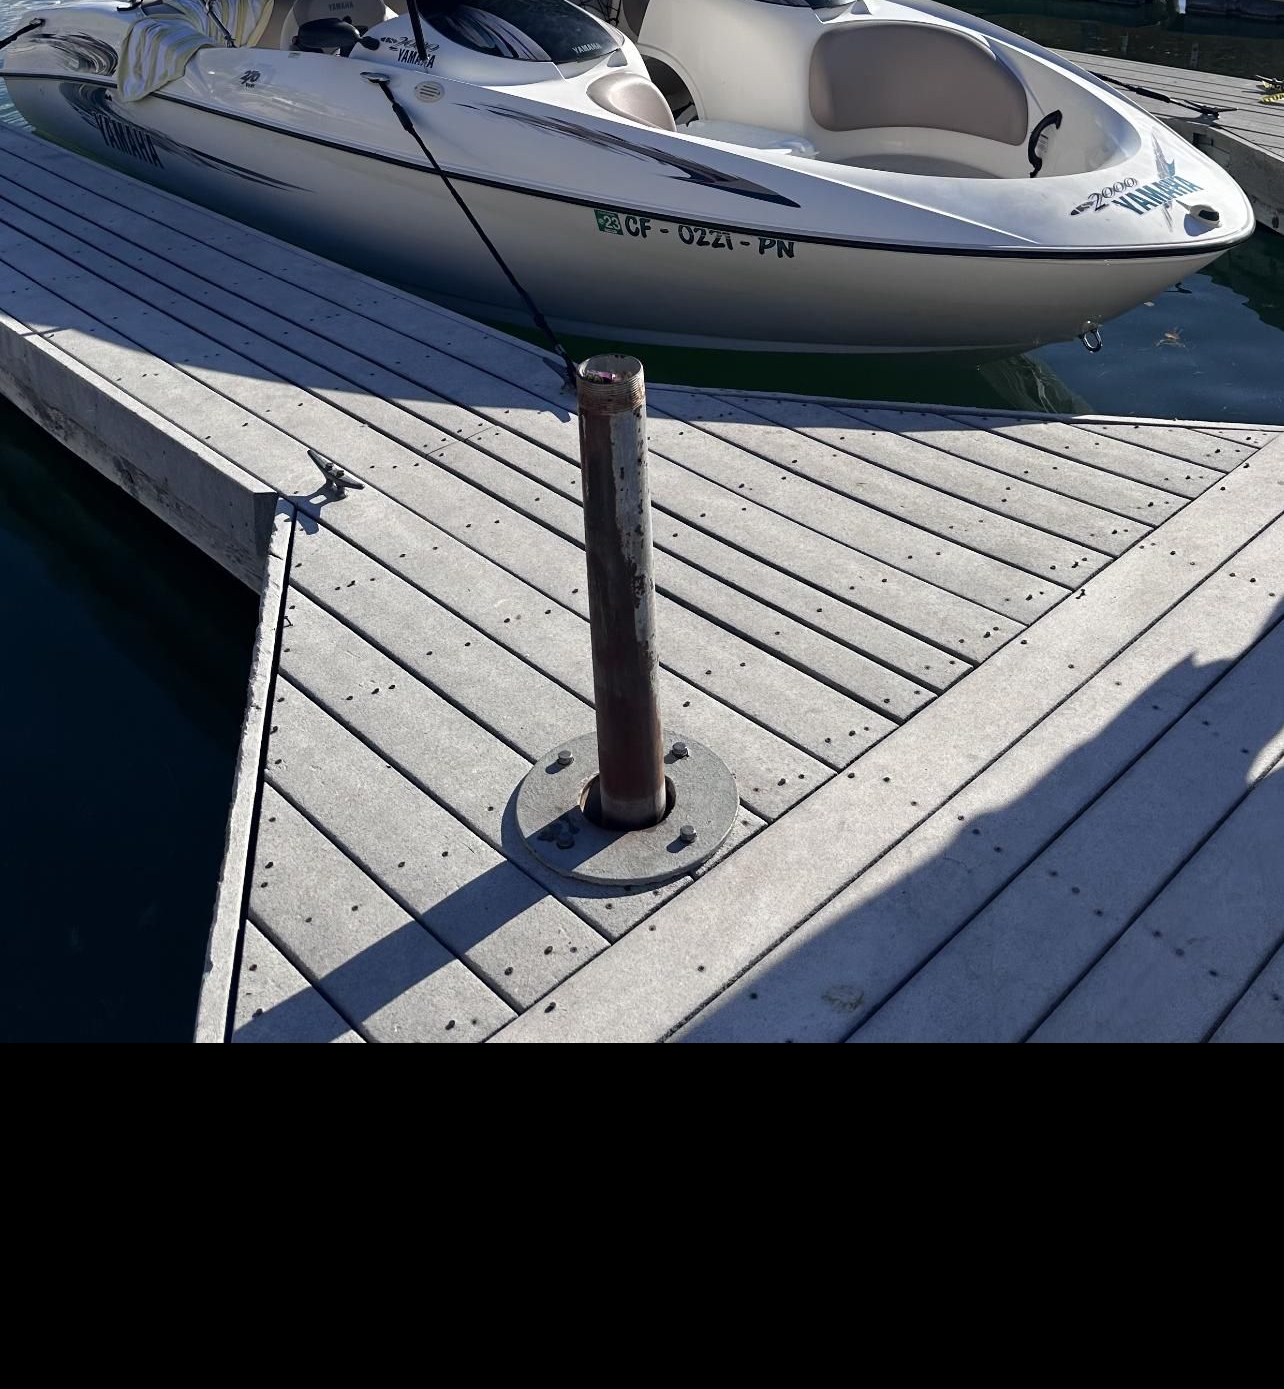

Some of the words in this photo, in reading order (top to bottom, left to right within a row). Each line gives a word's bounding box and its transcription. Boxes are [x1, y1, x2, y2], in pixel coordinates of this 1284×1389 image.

[328, 1, 354, 12] YAMAHA
[397, 48, 436, 69] YAMAA
[571, 42, 603, 54] YAMAHA
[95, 112, 165, 170] YAMAHA
[1111, 175, 1204, 216] YAMAHA
[603, 215, 621, 230] 23
[624, 215, 652, 239] CF
[758, 236, 795, 259] PN
